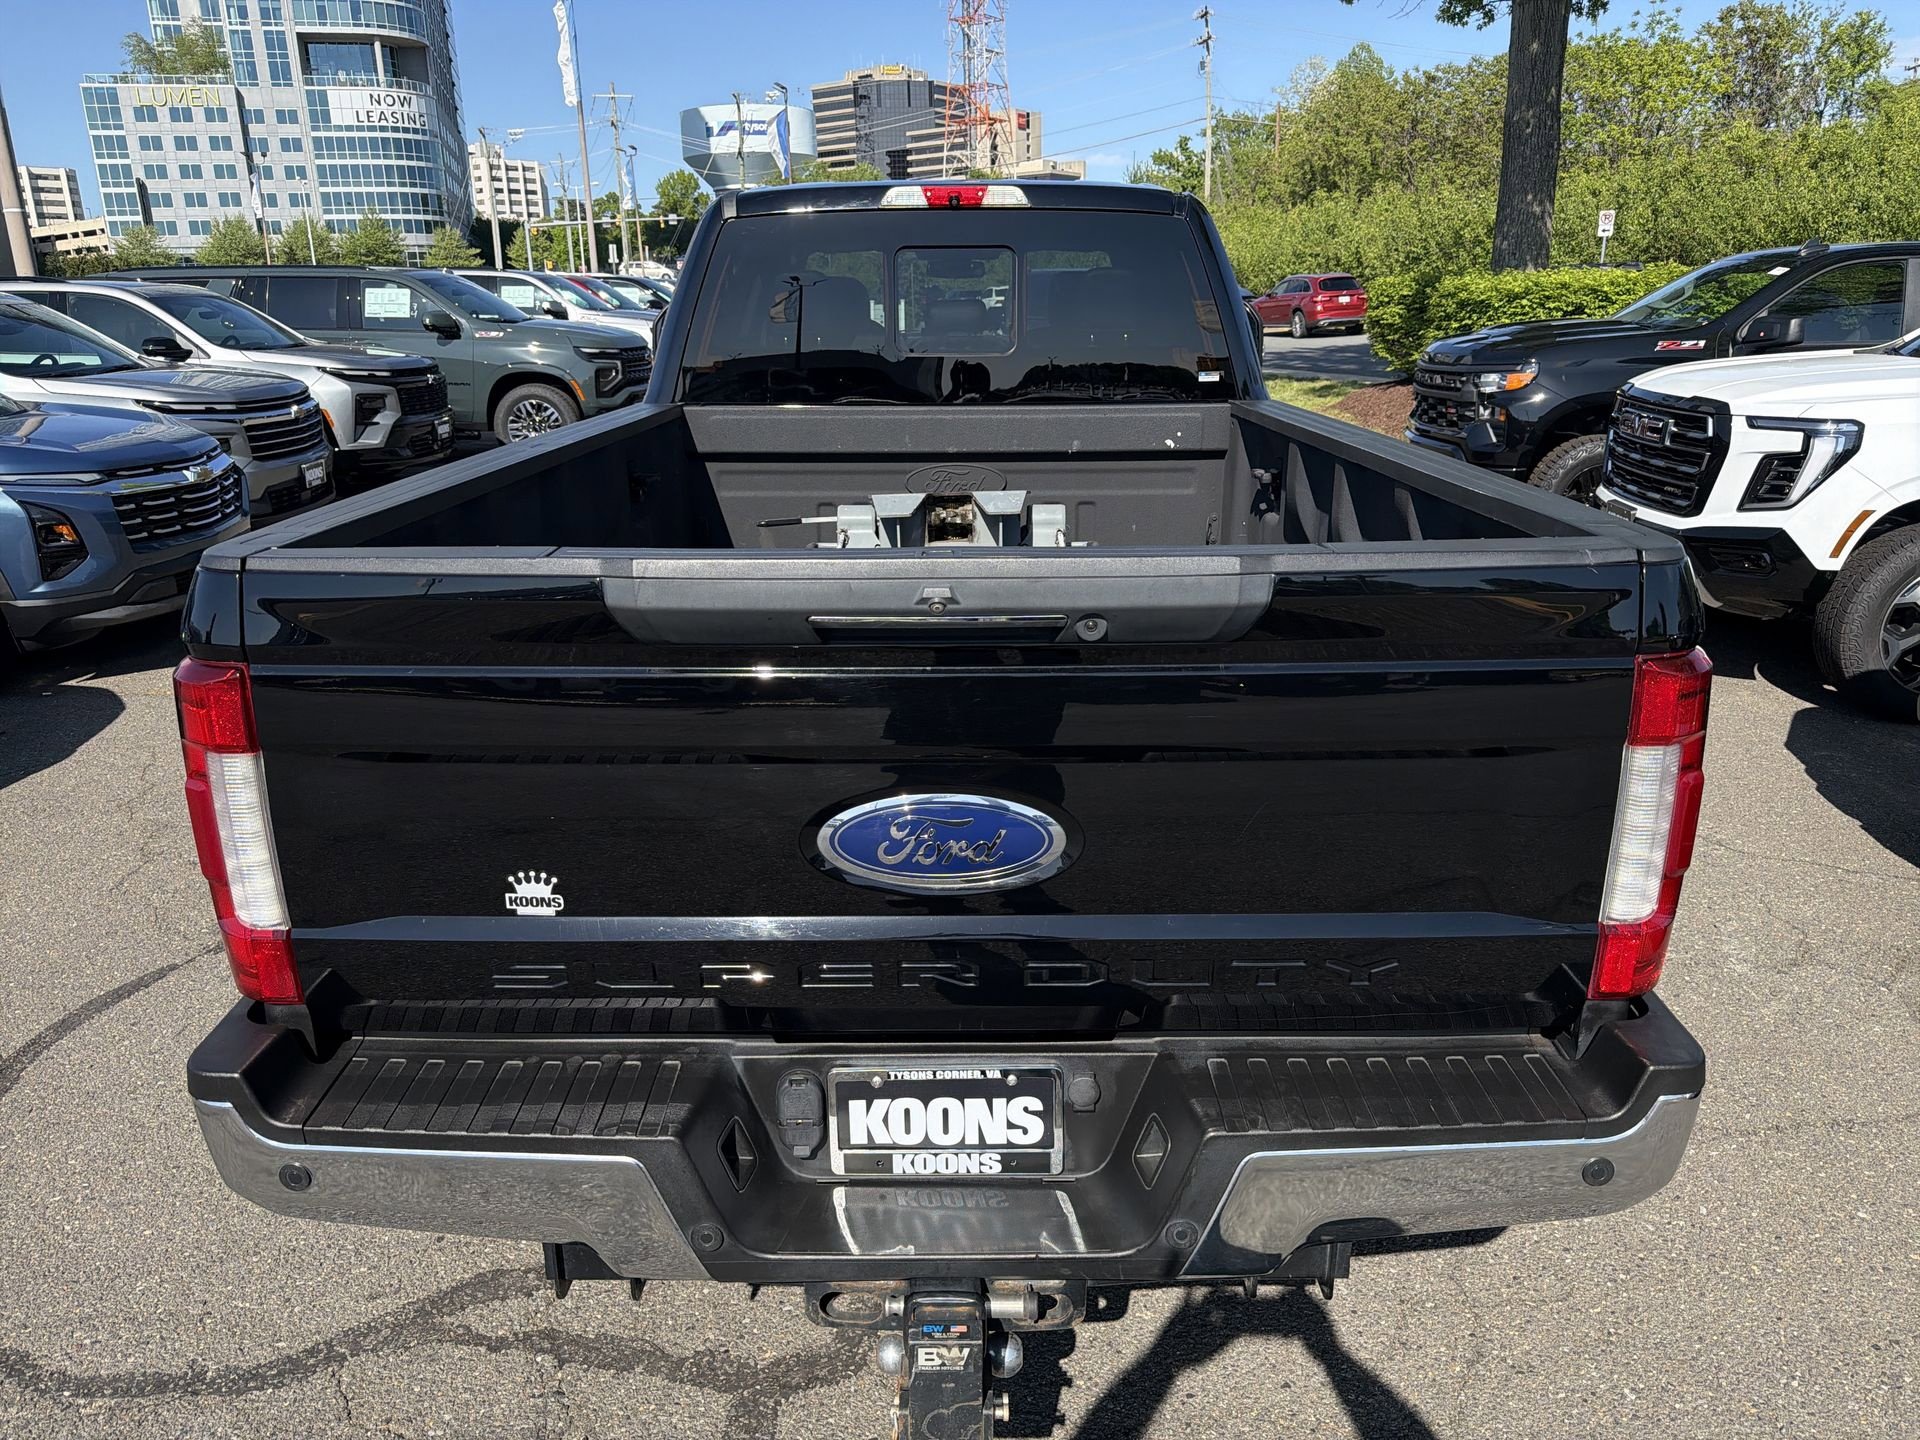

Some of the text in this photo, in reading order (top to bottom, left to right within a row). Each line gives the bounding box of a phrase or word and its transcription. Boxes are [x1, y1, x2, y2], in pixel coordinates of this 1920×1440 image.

[135, 87, 220, 107] LUMEN
[369, 93, 413, 109] NOW
[355, 108, 427, 128] LEASING
[1655, 340, 1706, 351] Z71
[1620, 412, 1664, 441] GMC
[925, 470, 987, 493] Ford
[877, 815, 1007, 866] Ford
[508, 895, 562, 908] KOONS
[491, 958, 1399, 989] SUPER DUTY
[889, 1070, 934, 1080] TYSONS
[986, 1069, 1001, 1078] VA
[848, 1096, 1045, 1146] KOONS
[892, 1153, 1002, 1174] KOONS
